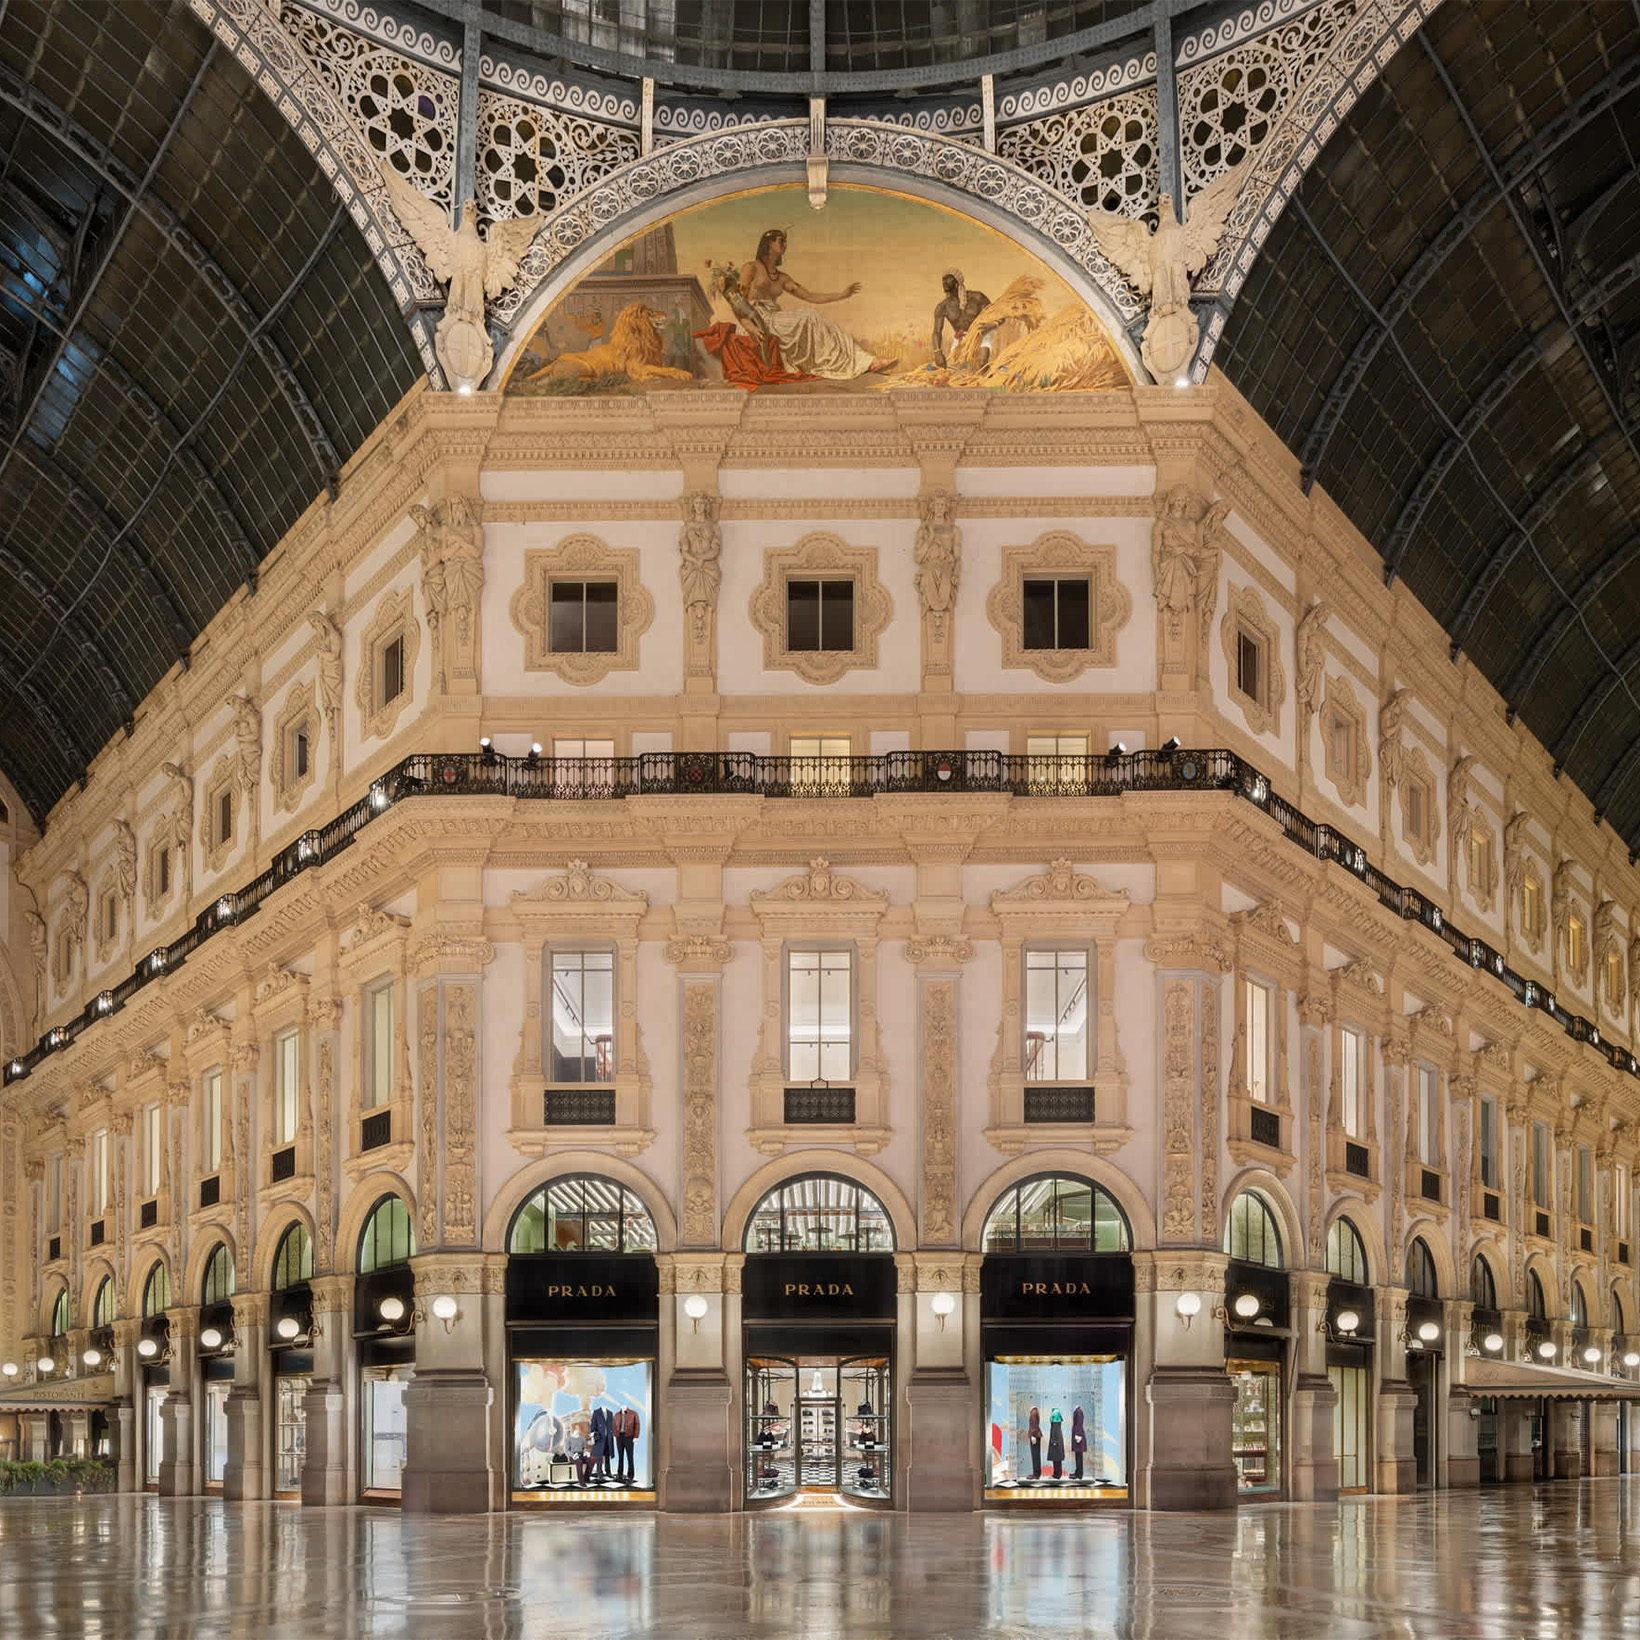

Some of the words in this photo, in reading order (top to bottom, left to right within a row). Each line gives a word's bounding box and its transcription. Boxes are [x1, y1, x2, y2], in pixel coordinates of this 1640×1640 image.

[548, 1285, 617, 1297] PRADA
[785, 1284, 854, 1296] PRADA
[1022, 1282, 1091, 1295] PRADA
